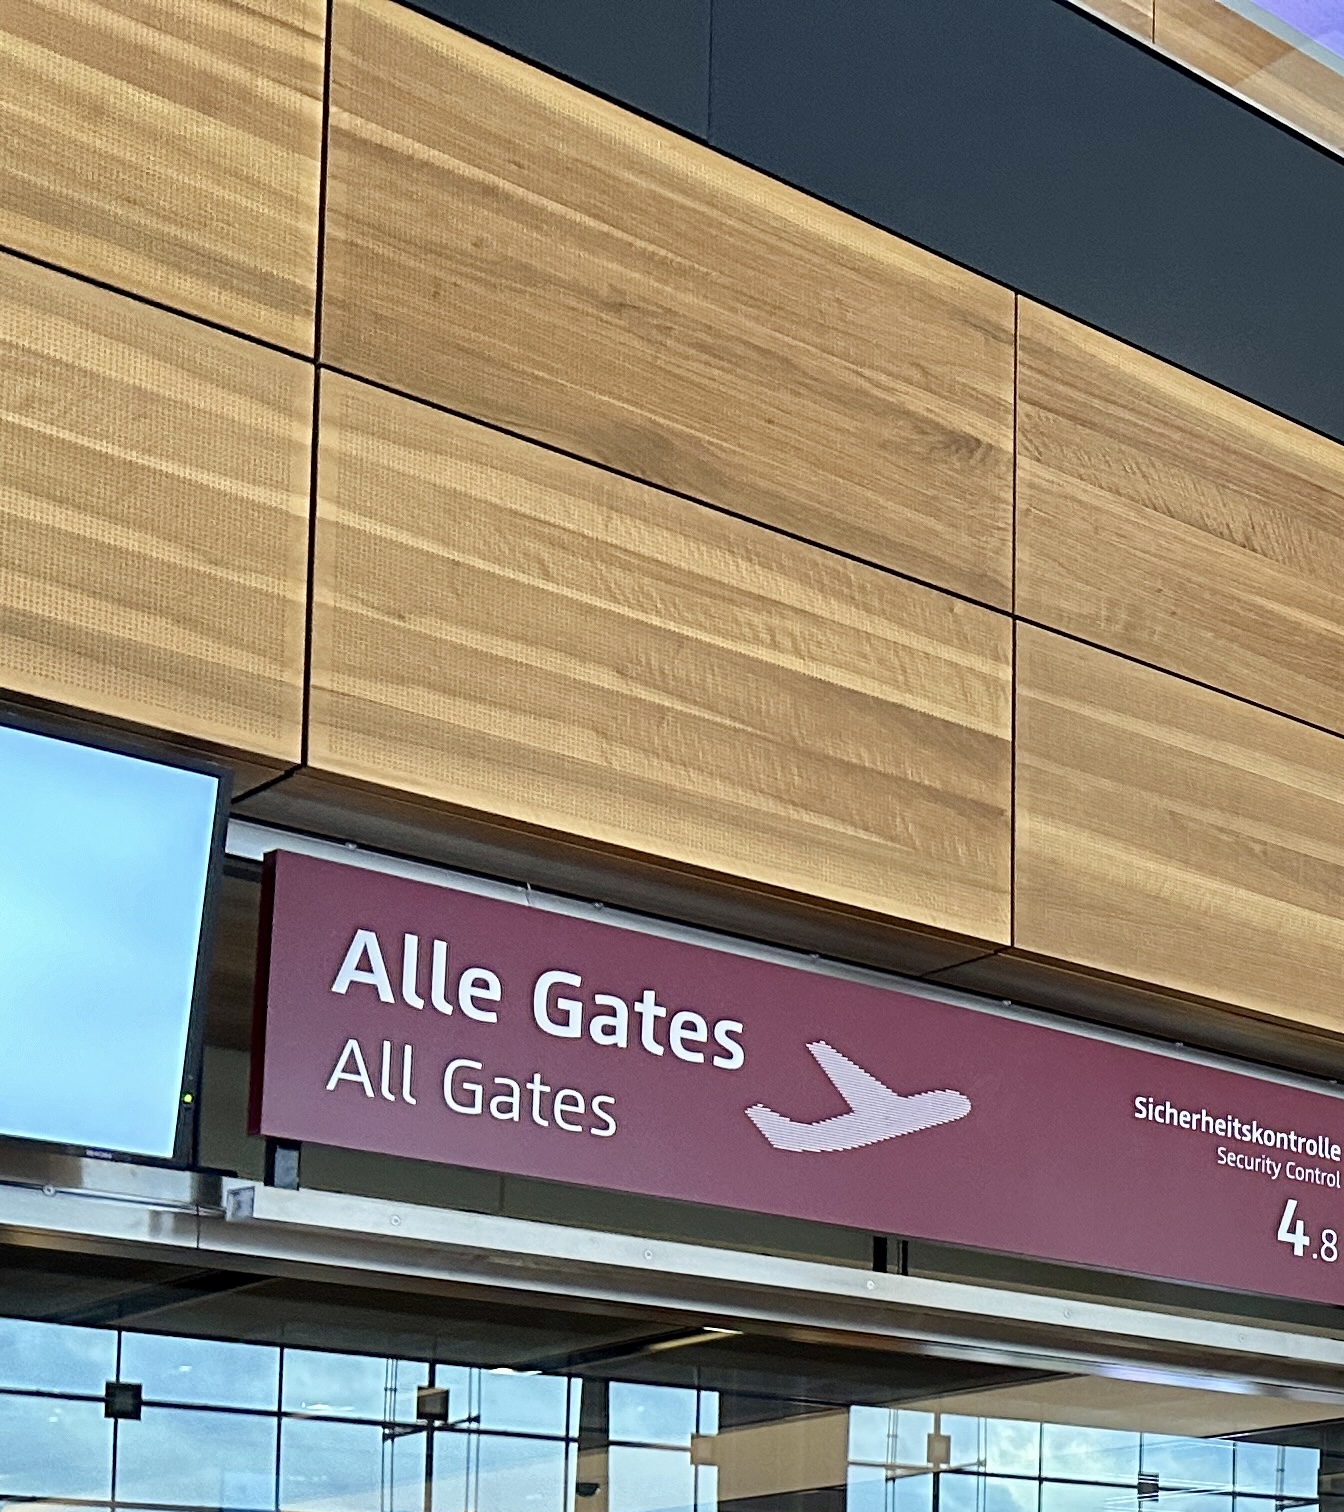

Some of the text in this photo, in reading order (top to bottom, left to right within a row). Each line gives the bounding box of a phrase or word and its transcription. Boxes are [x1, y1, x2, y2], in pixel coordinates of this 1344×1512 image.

[330, 928, 746, 1071] Alle Gates
[326, 1037, 618, 1138] All Gates
[1133, 1095, 1342, 1162] Sicherheitskontrolle
[1216, 1147, 1342, 1190] Security Control
[1276, 1198, 1339, 1263] 4.8
